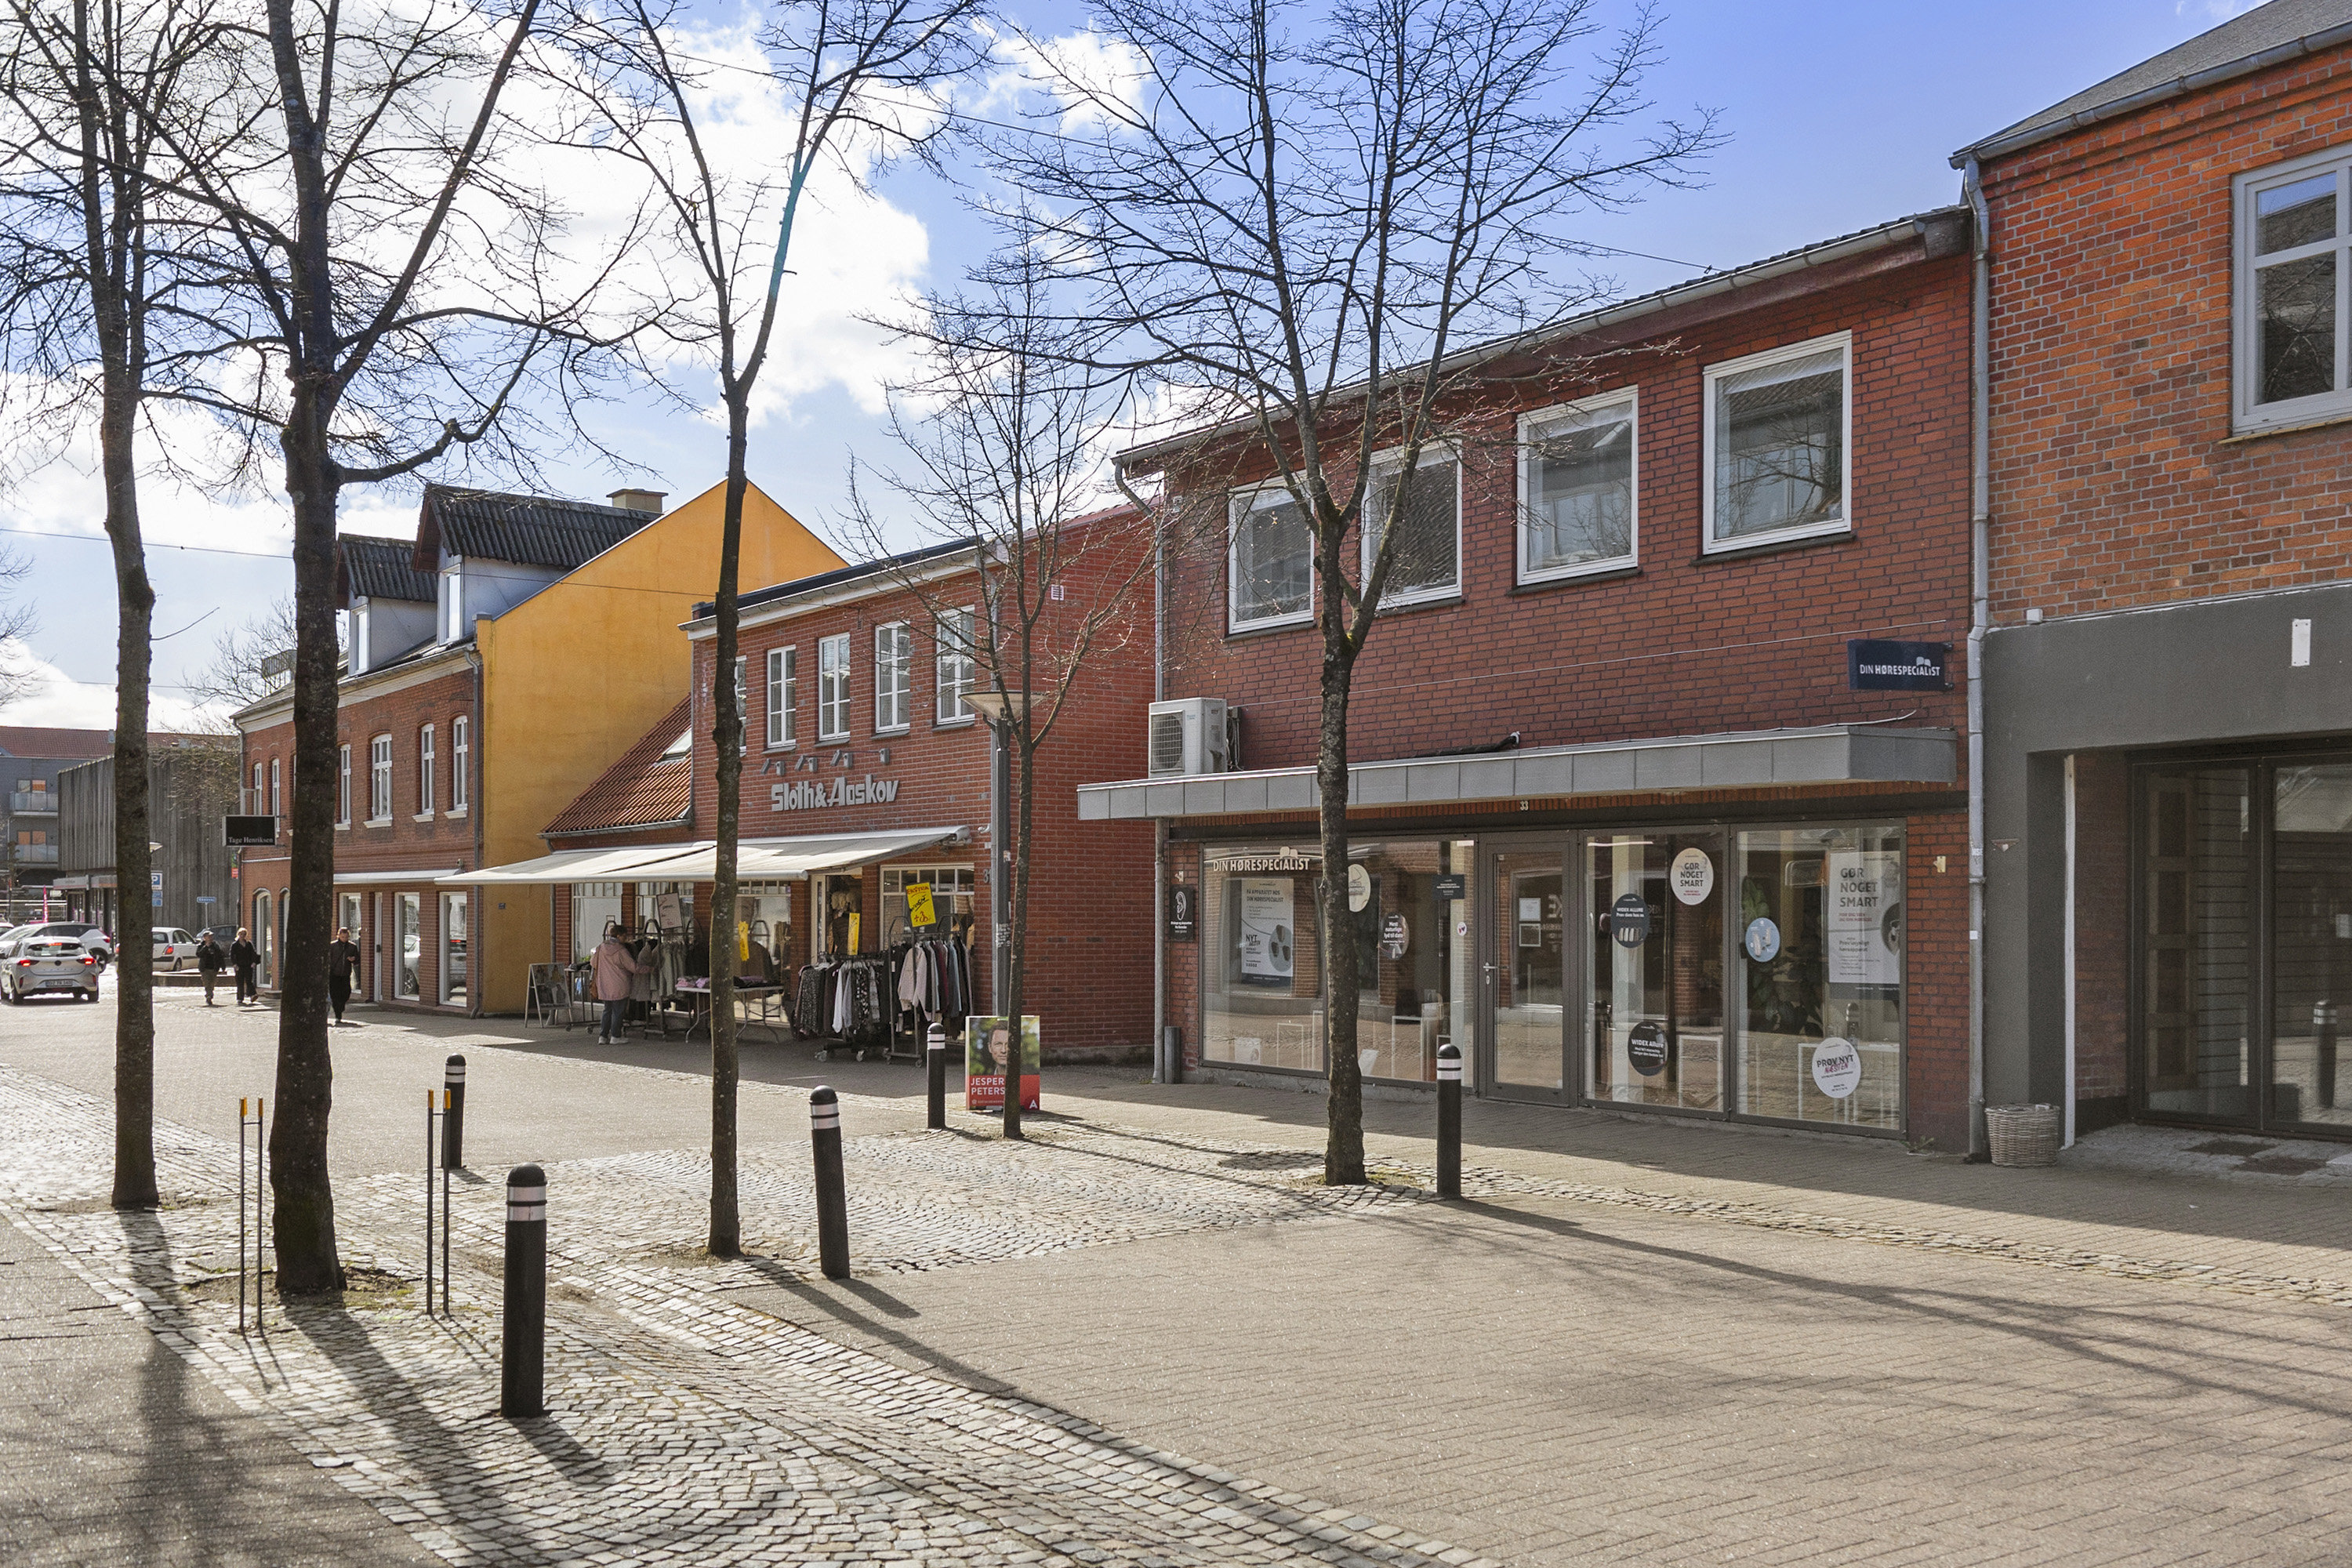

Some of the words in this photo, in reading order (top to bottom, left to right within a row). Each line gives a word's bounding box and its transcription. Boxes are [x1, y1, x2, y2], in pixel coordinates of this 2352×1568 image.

[1860, 664, 1874, 674] DIN
[1875, 664, 1940, 676] HØRESPECIALIST
[1213, 860, 1229, 872] DIN
[1229, 858, 1310, 871] HØRESPECIALIST
[1840, 881, 1878, 893] NOGET
[1839, 896, 1878, 907] SMART
[1838, 1054, 1854, 1064] NYT
[971, 1077, 1004, 1086] JESPER
[1029, 1099, 1038, 1109] A
